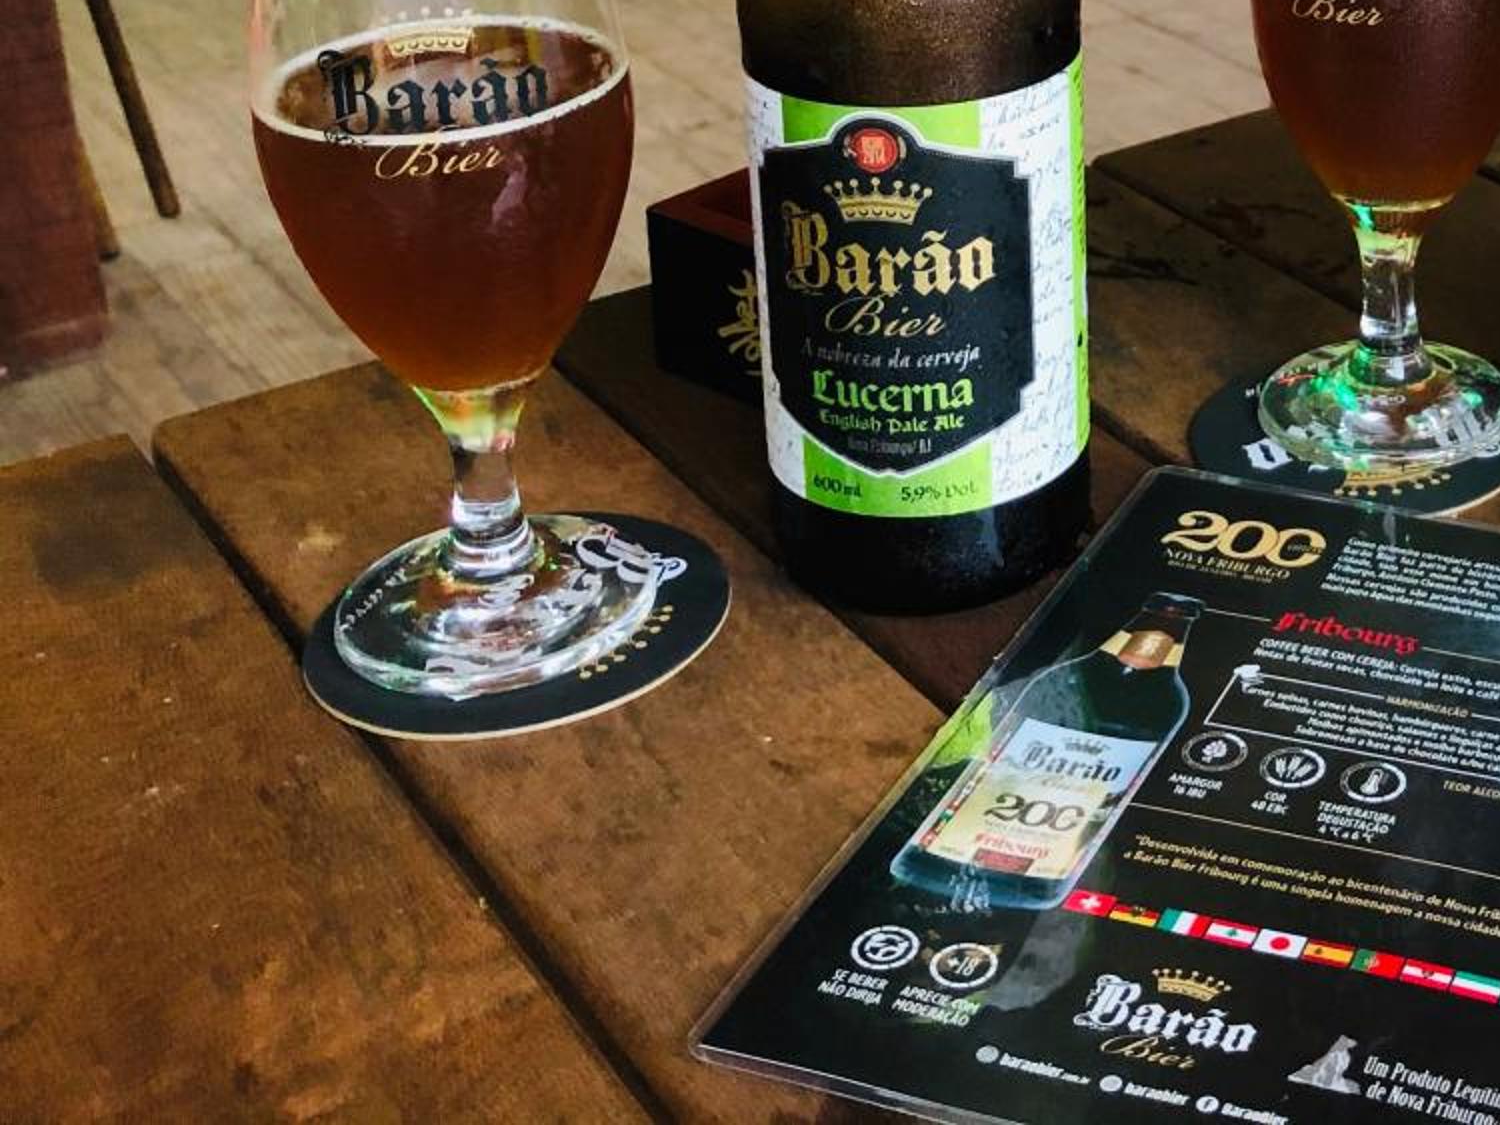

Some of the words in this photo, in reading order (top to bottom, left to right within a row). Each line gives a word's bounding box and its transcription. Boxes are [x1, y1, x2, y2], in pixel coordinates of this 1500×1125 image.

[318, 49, 549, 146] Barão
[375, 135, 506, 179] Bier
[782, 200, 997, 297] Barão
[825, 293, 948, 338] Bier
[888, 347, 911, 368] da
[917, 344, 981, 372] cerveja
[812, 369, 975, 412] Lucerna
[819, 409, 882, 433] English
[888, 417, 928, 435] Pale
[934, 413, 965, 431] Ale
[901, 486, 941, 504] 5,9%
[1272, 610, 1421, 656] Fribourg
[1169, 773, 1223, 790] AMARGOR
[1264, 791, 1287, 803] COR
[1319, 801, 1396, 825] TEMPERATURA
[1133, 850, 1170, 866] Barão
[1259, 879, 1289, 892] uma
[1335, 891, 1413, 916] homenagem
[1424, 912, 1462, 928] nossa
[1219, 854, 1240, 866] em
[1241, 859, 1327, 882] comemoração
[1327, 876, 1345, 887] ao
[1345, 879, 1425, 902] bicentenário
[1425, 894, 1443, 907] de
[1443, 898, 1477, 915] Nova
[817, 980, 847, 996] NÃO
[844, 986, 882, 1005] DIRIJA
[831, 968, 850, 982] SE
[847, 972, 889, 990] BEBER
[892, 999, 970, 1026] MODERAÇÃO
[899, 986, 952, 1008] APRECIE
[950, 998, 981, 1014] COM
[1074, 975, 1255, 1052] Barão
[1100, 1029, 1195, 1068] Bier
[1363, 1056, 1390, 1078] Um
[1390, 1062, 1451, 1094] Produto
[1365, 1080, 1387, 1100] de
[1387, 1085, 1425, 1111] Nova
